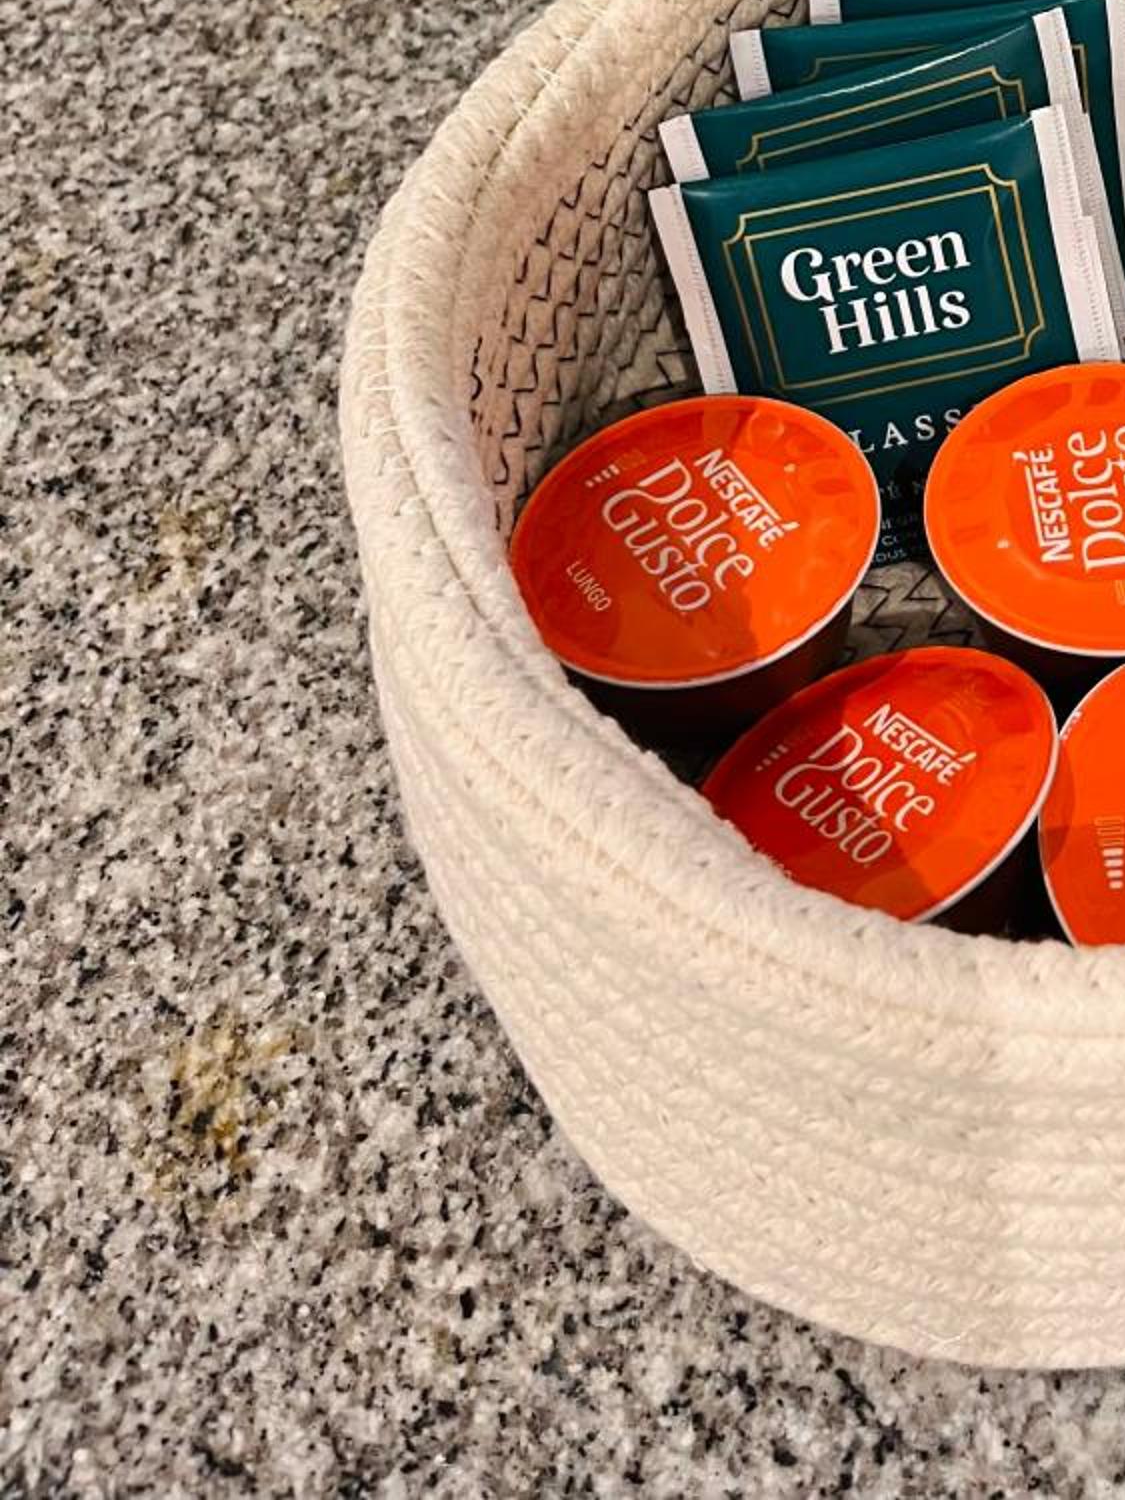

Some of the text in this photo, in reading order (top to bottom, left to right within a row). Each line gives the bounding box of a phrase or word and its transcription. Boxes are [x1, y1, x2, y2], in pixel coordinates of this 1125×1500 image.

[779, 230, 972, 303] Green
[819, 287, 972, 355] Hills
[848, 408, 961, 453] LASS
[637, 457, 754, 590] Dolce
[694, 448, 799, 548] NESCAFÉ
[1013, 449, 1075, 563] NESCAFÉ
[566, 561, 612, 612] LUNGO
[602, 489, 711, 611] Gusto
[809, 724, 935, 831] Dolce
[863, 703, 976, 785] NESCAFÉ
[775, 763, 892, 863] Gusto
